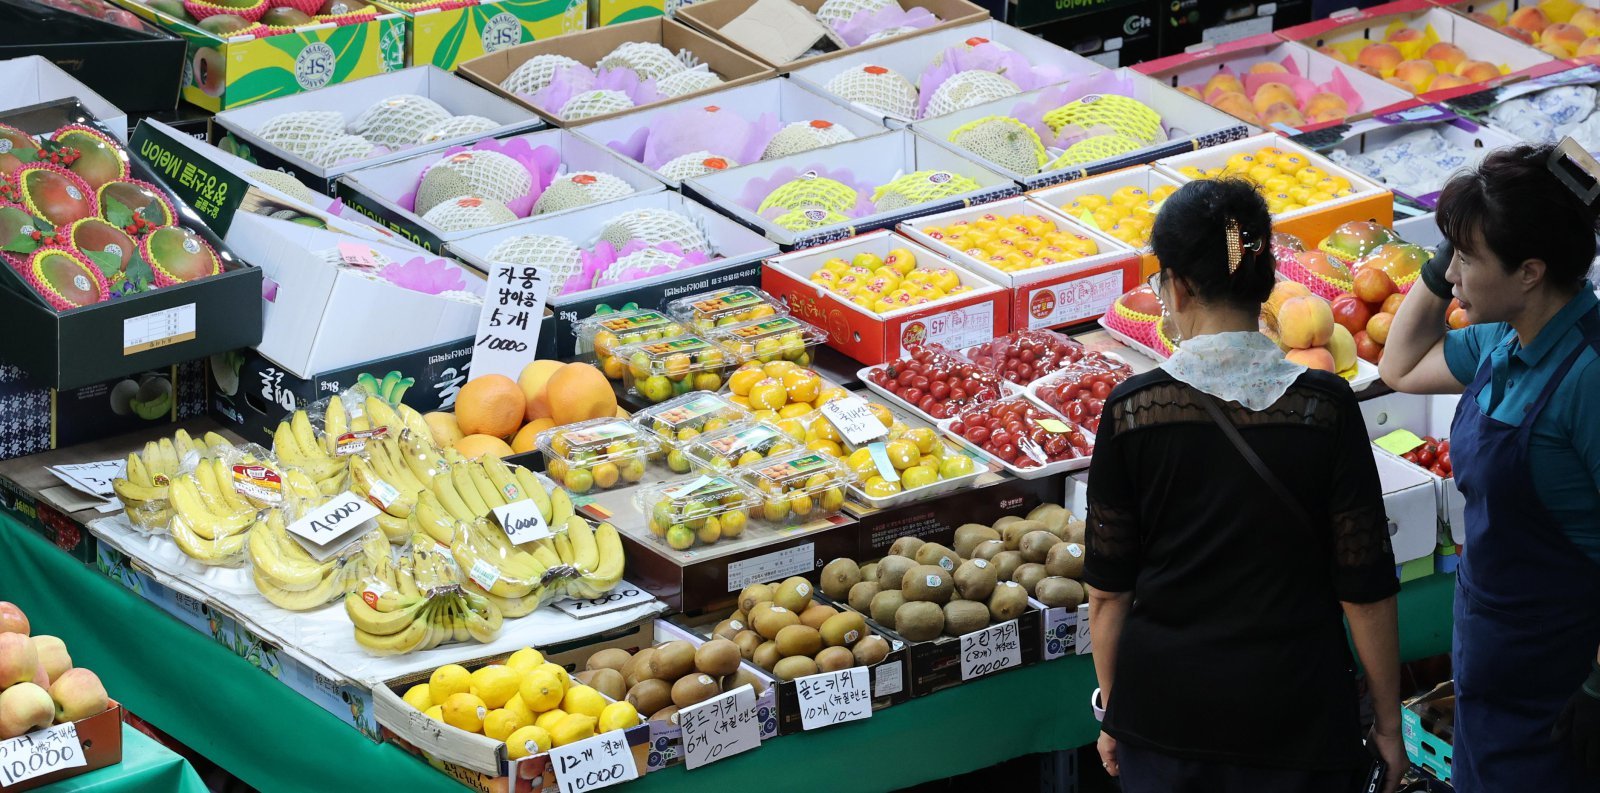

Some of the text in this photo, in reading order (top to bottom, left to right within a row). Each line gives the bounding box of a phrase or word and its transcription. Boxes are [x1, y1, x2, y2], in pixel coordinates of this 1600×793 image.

[494, 26, 513, 45] SF
[305, 57, 326, 75] SF
[140, 138, 228, 207] 청정산골 Melon
[498, 266, 541, 289] 자몽
[498, 287, 538, 308] 남아공
[1059, 288, 1074, 304] 38
[489, 307, 529, 330] 5개
[559, 310, 578, 322] 8kg
[931, 320, 946, 334] 45
[258, 367, 296, 412] 멜론
[320, 381, 340, 393] 8kg
[804, 702, 830, 719] 10개
[46, 725, 78, 743] 국내산
[687, 729, 709, 754] 6개
[560, 739, 625, 775] 12개 칠레
